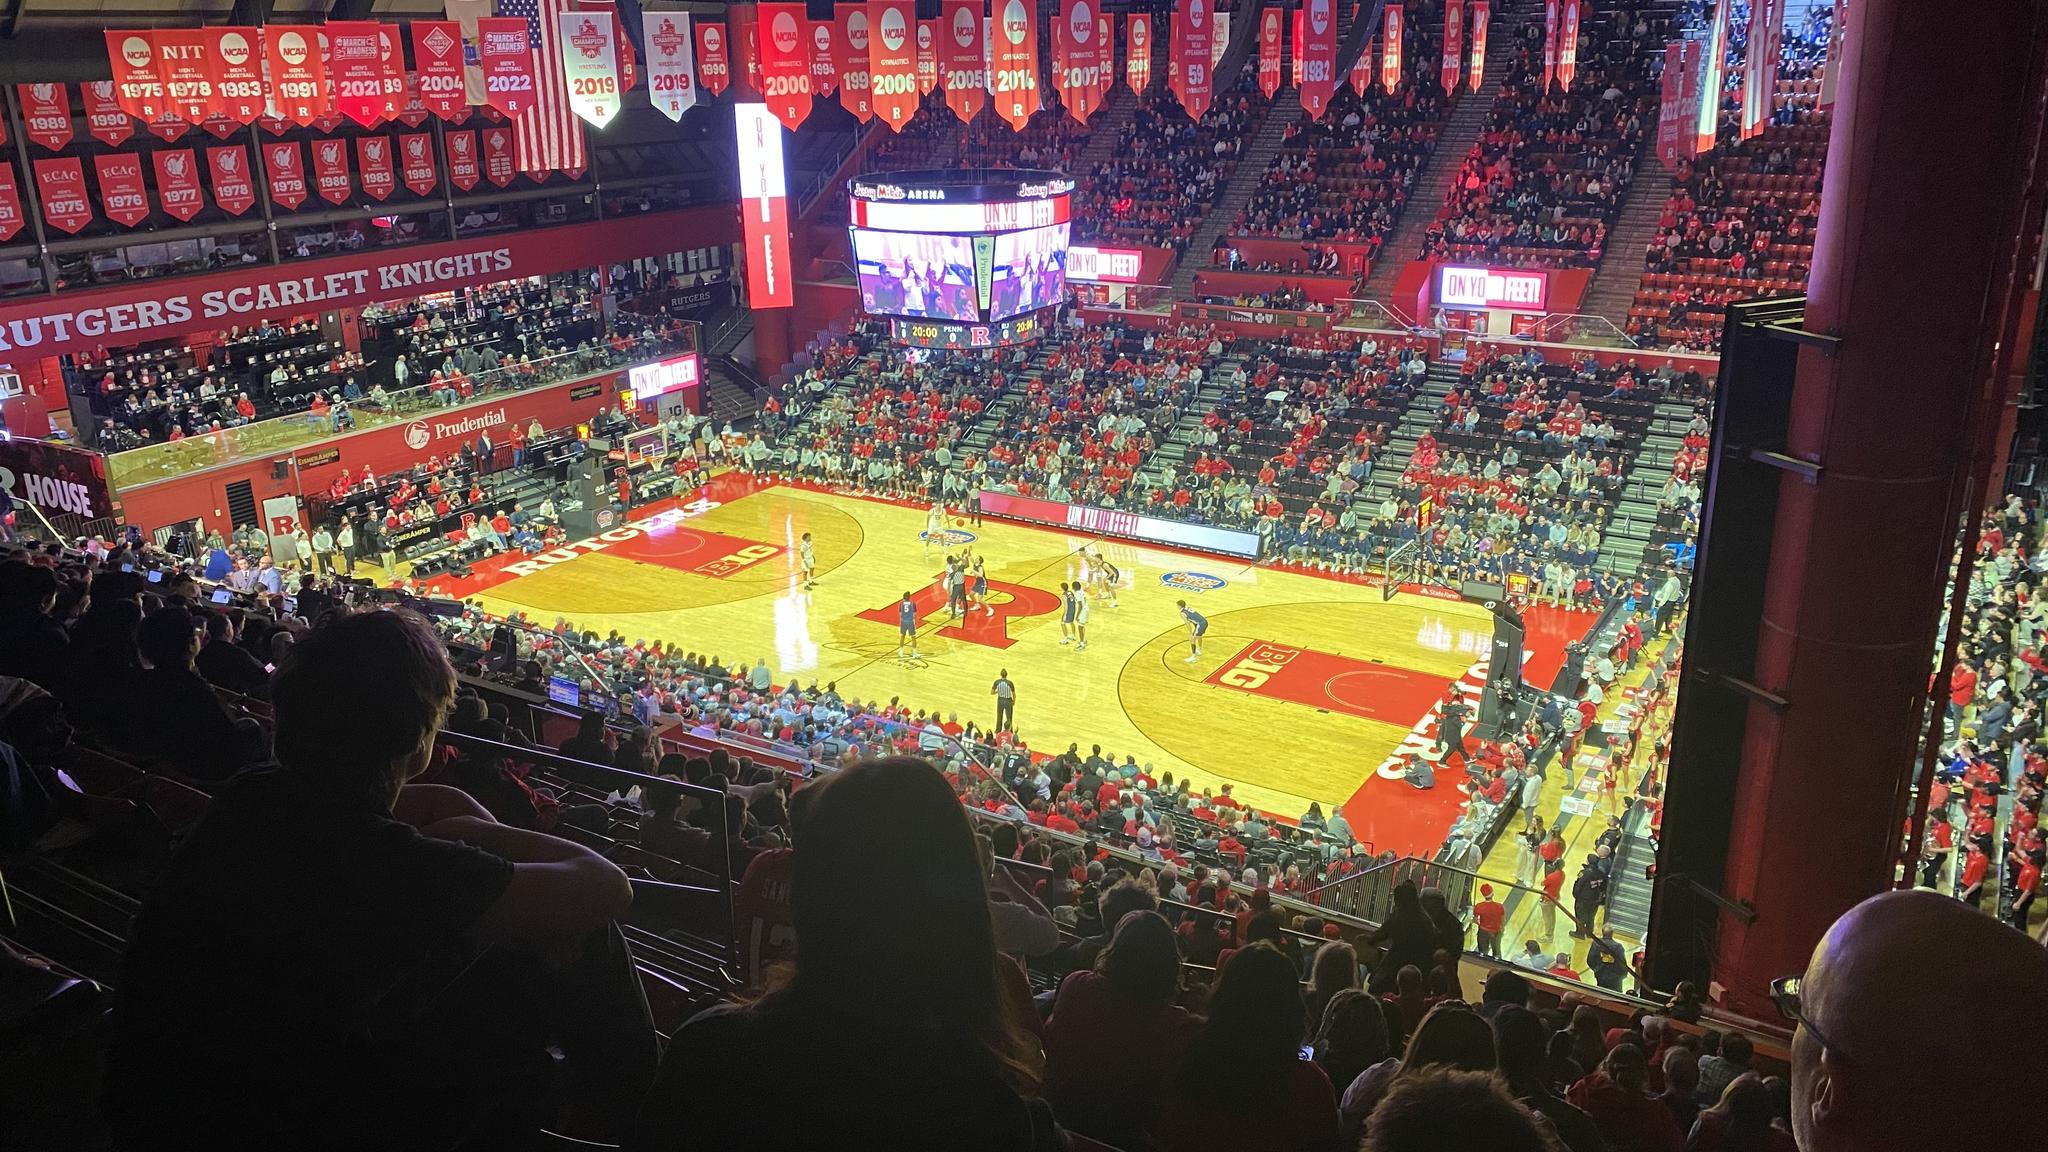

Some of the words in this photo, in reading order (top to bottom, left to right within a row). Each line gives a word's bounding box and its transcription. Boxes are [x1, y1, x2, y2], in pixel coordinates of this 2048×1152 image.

[956, 26, 974, 37] NCAA
[1006, 21, 1027, 32] NCAA
[1072, 22, 1092, 32] NCAA
[492, 34, 515, 42] MARCH
[774, 32, 798, 42] NCAA
[884, 28, 905, 39] NCAA
[342, 38, 366, 46] MARCH
[574, 38, 606, 46] CHAMPION
[654, 36, 684, 44] CHAMPION
[160, 45, 204, 60] NIT
[224, 48, 249, 56] NCAA
[282, 48, 307, 56] NCAA
[346, 47, 377, 55] MADNESS
[496, 42, 526, 51] MADNESS
[127, 51, 151, 59] NCAA
[1002, 52, 1030, 61] GYMNASTICS
[880, 58, 910, 66] GYMNASTICS
[1260, 58, 1280, 73] 2010
[702, 64, 726, 75] 1990
[812, 62, 835, 75] 1994
[1188, 64, 1204, 85] 59
[1304, 60, 1330, 82] 1982
[654, 74, 690, 91] 2019
[843, 72, 870, 90] 199
[948, 70, 984, 90] 2005
[998, 69, 1036, 92] 2014
[1063, 66, 1100, 88] 2007
[167, 81, 212, 97] 1978
[218, 80, 262, 98] 1983
[340, 80, 381, 98] 2021
[420, 76, 464, 92] 2004
[488, 75, 532, 92] 2022
[574, 76, 615, 95] 2019
[766, 74, 810, 96] 2000
[873, 72, 916, 96] 2006
[121, 82, 163, 98] 1975
[280, 82, 318, 98] 1991
[442, 102, 450, 111] R
[508, 101, 517, 111] R
[670, 101, 679, 111] R
[860, 100, 868, 112] R
[1312, 96, 1319, 108] R
[144, 106, 154, 115] R
[190, 106, 200, 116] R
[240, 106, 250, 116] R
[298, 106, 309, 116] R
[362, 106, 370, 116] R
[595, 106, 605, 116] R
[788, 107, 796, 118] R
[892, 106, 901, 120] R
[1014, 104, 1024, 117] R
[30, 117, 67, 130] 1989
[90, 114, 128, 126] 1990
[50, 136, 60, 144] R
[110, 132, 118, 140] R
[1668, 147, 1674, 158] R
[102, 166, 136, 179] ECAC
[406, 168, 432, 180] 1989
[454, 164, 474, 176] 1991
[42, 170, 78, 184] ECAC
[320, 176, 348, 188] 1980
[364, 172, 390, 184] 1983
[218, 184, 248, 198] 1978
[272, 180, 302, 192] 1979
[1016, 182, 1048, 198] Jersey
[108, 194, 142, 208] 1976
[164, 189, 196, 202] 1977
[908, 190, 945, 200] ARENA
[48, 200, 85, 214] 1975
[67, 219, 76, 227] R
[1069, 252, 1084, 272] ON
[201, 269, 369, 318] SCARLET
[378, 248, 513, 290] KNIGHTS
[979, 257, 990, 298] Prudential
[1449, 274, 1466, 298] ON
[672, 292, 710, 306] RUTGERS
[912, 326, 938, 338] 20:00
[970, 327, 991, 346] R
[434, 408, 506, 440] Prudential
[23, 473, 94, 518] HOUSE
[271, 514, 296, 536] R
[1112, 511, 1138, 536] FEET!
[499, 499, 722, 577] RUTGERS
[1512, 584, 1524, 592] 30
[858, 571, 1061, 650] R
[904, 605, 909, 613] 5
